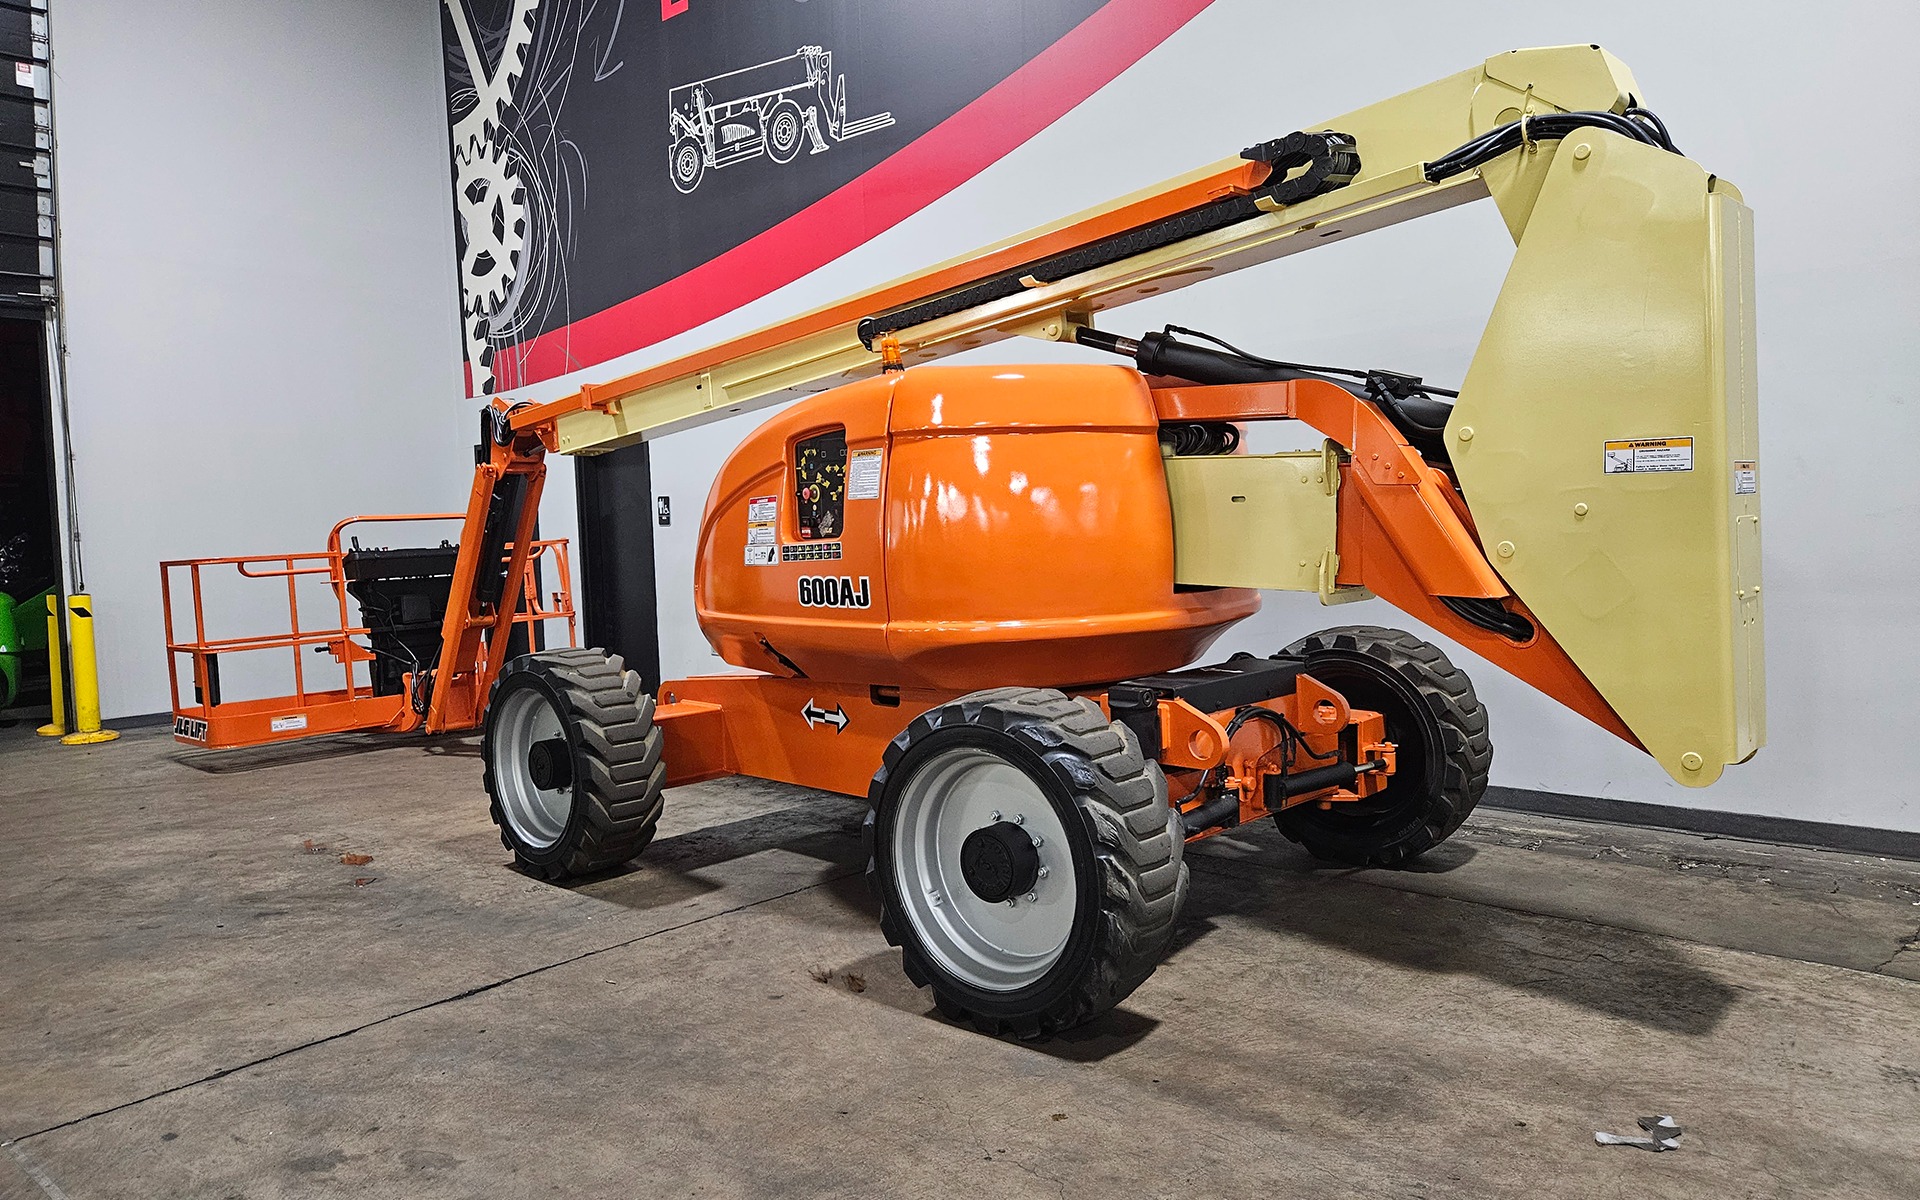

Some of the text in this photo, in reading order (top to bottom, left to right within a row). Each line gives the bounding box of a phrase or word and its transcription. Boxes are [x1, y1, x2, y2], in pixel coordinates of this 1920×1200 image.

[799, 577, 870, 607] 600AJ
[174, 716, 207, 740] JLG LIFT
